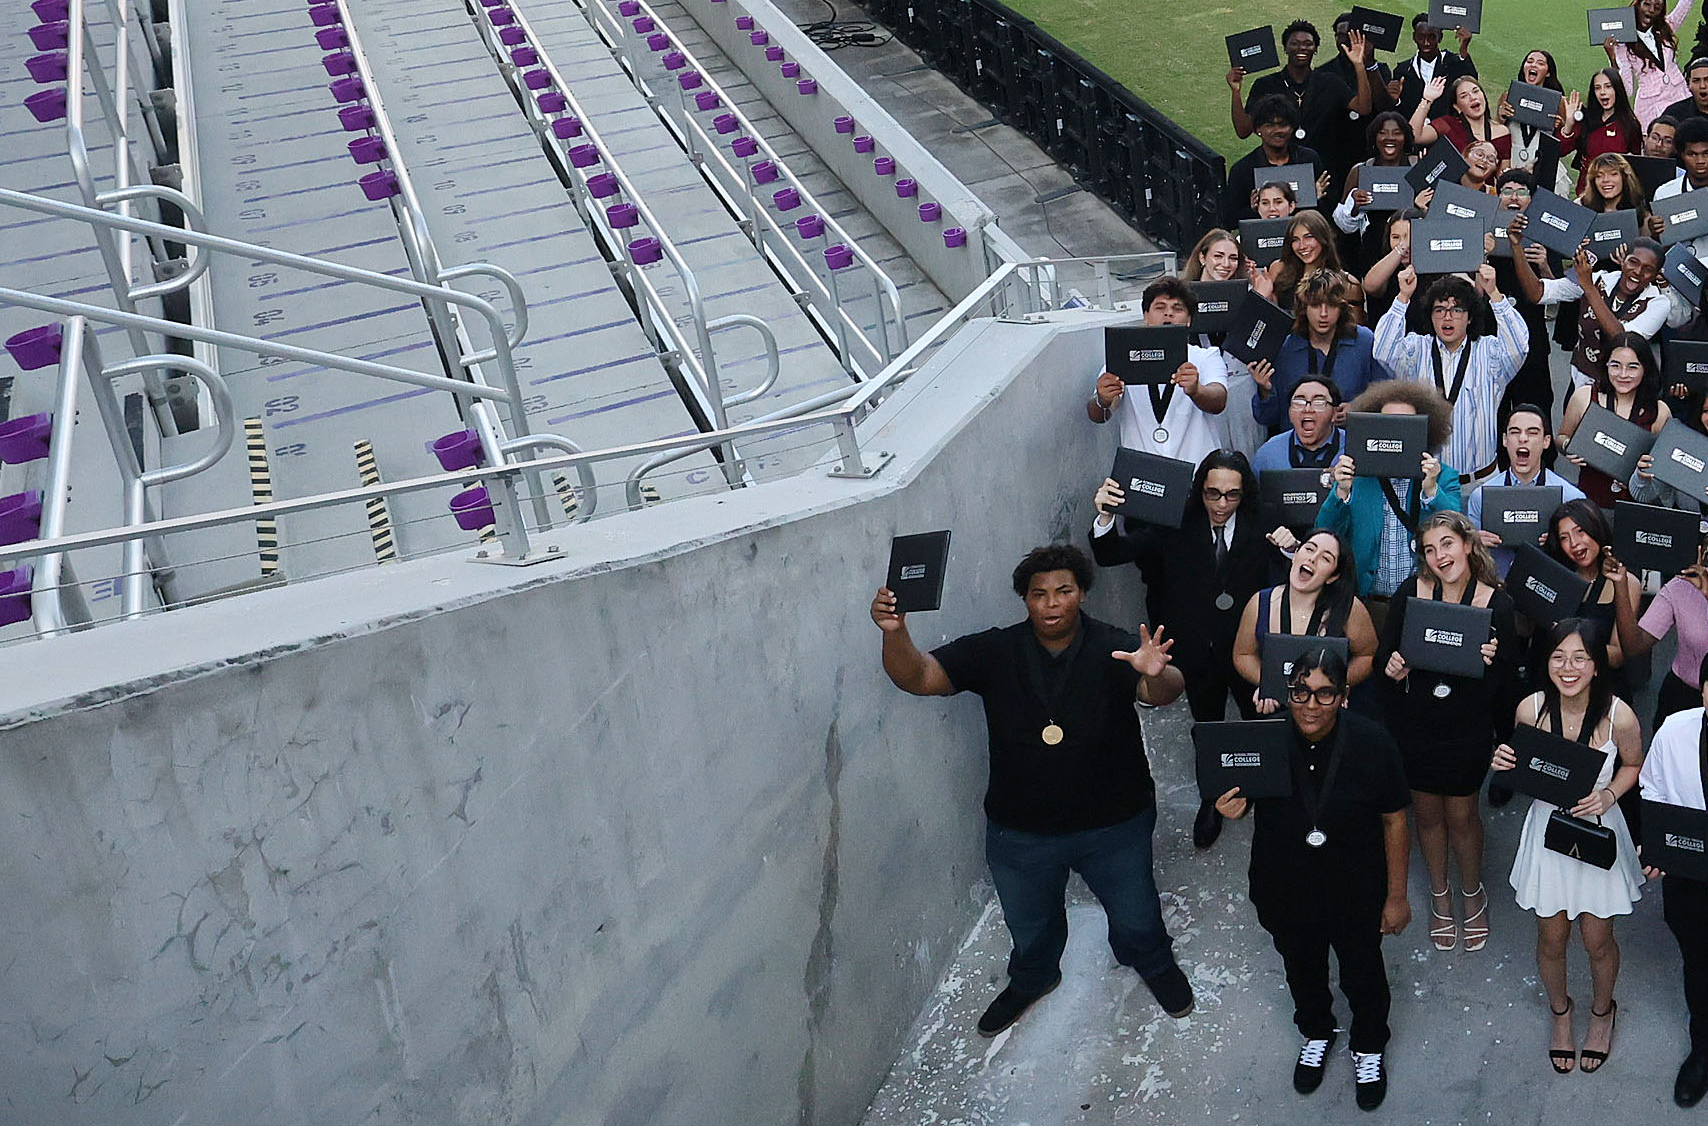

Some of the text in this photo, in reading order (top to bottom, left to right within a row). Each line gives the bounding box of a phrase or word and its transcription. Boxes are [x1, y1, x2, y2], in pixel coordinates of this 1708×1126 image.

[1141, 484, 1164, 493] COLLEGE
[1648, 536, 1671, 544] COLLEGE
[1438, 634, 1462, 643] COLLEGE
[1543, 765, 1568, 778] COLLEGE
[1678, 839, 1704, 849] COLLEGE
